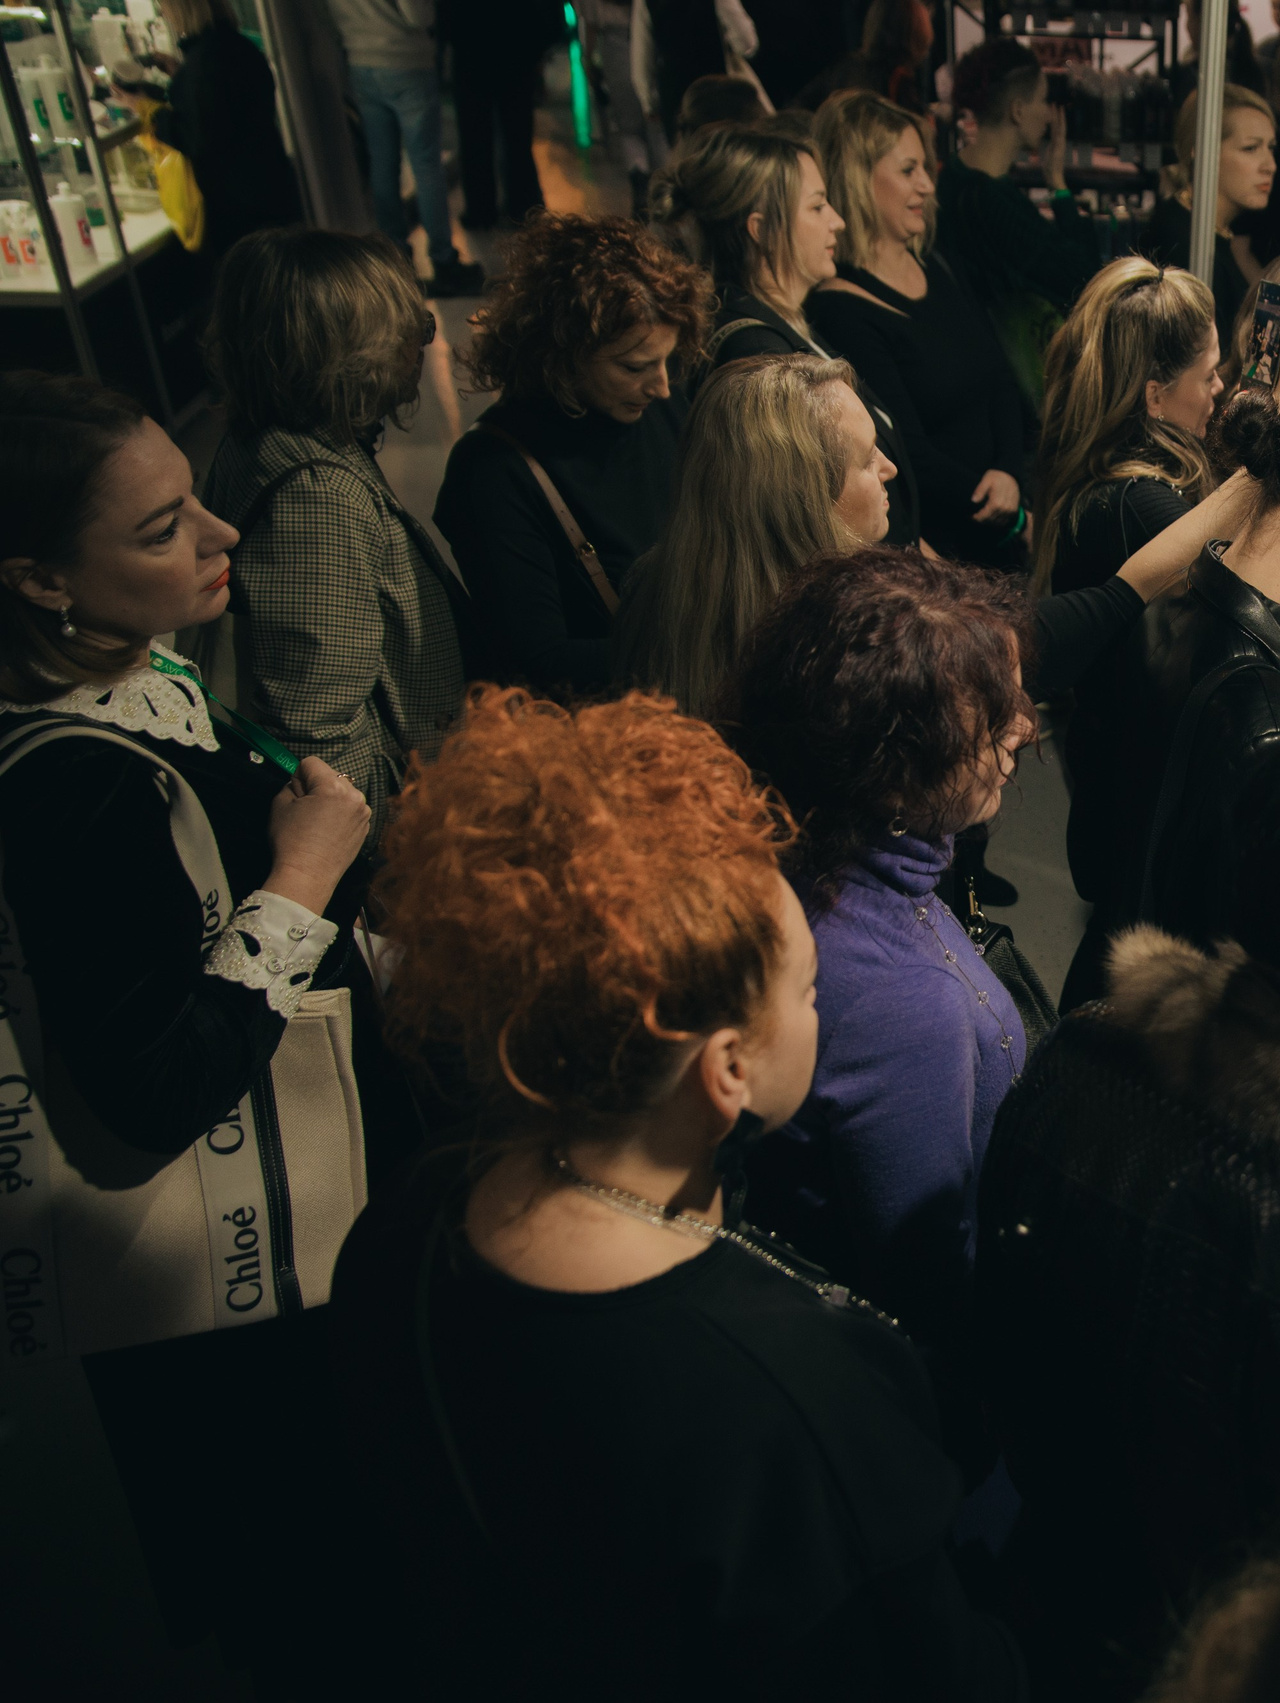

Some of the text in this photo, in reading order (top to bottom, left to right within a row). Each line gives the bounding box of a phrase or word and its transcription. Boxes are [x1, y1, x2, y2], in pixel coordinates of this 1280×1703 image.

[0, 1073, 34, 1195] Chloé
[1, 1246, 48, 1358] Chloé
[223, 1206, 264, 1313] Chloé
